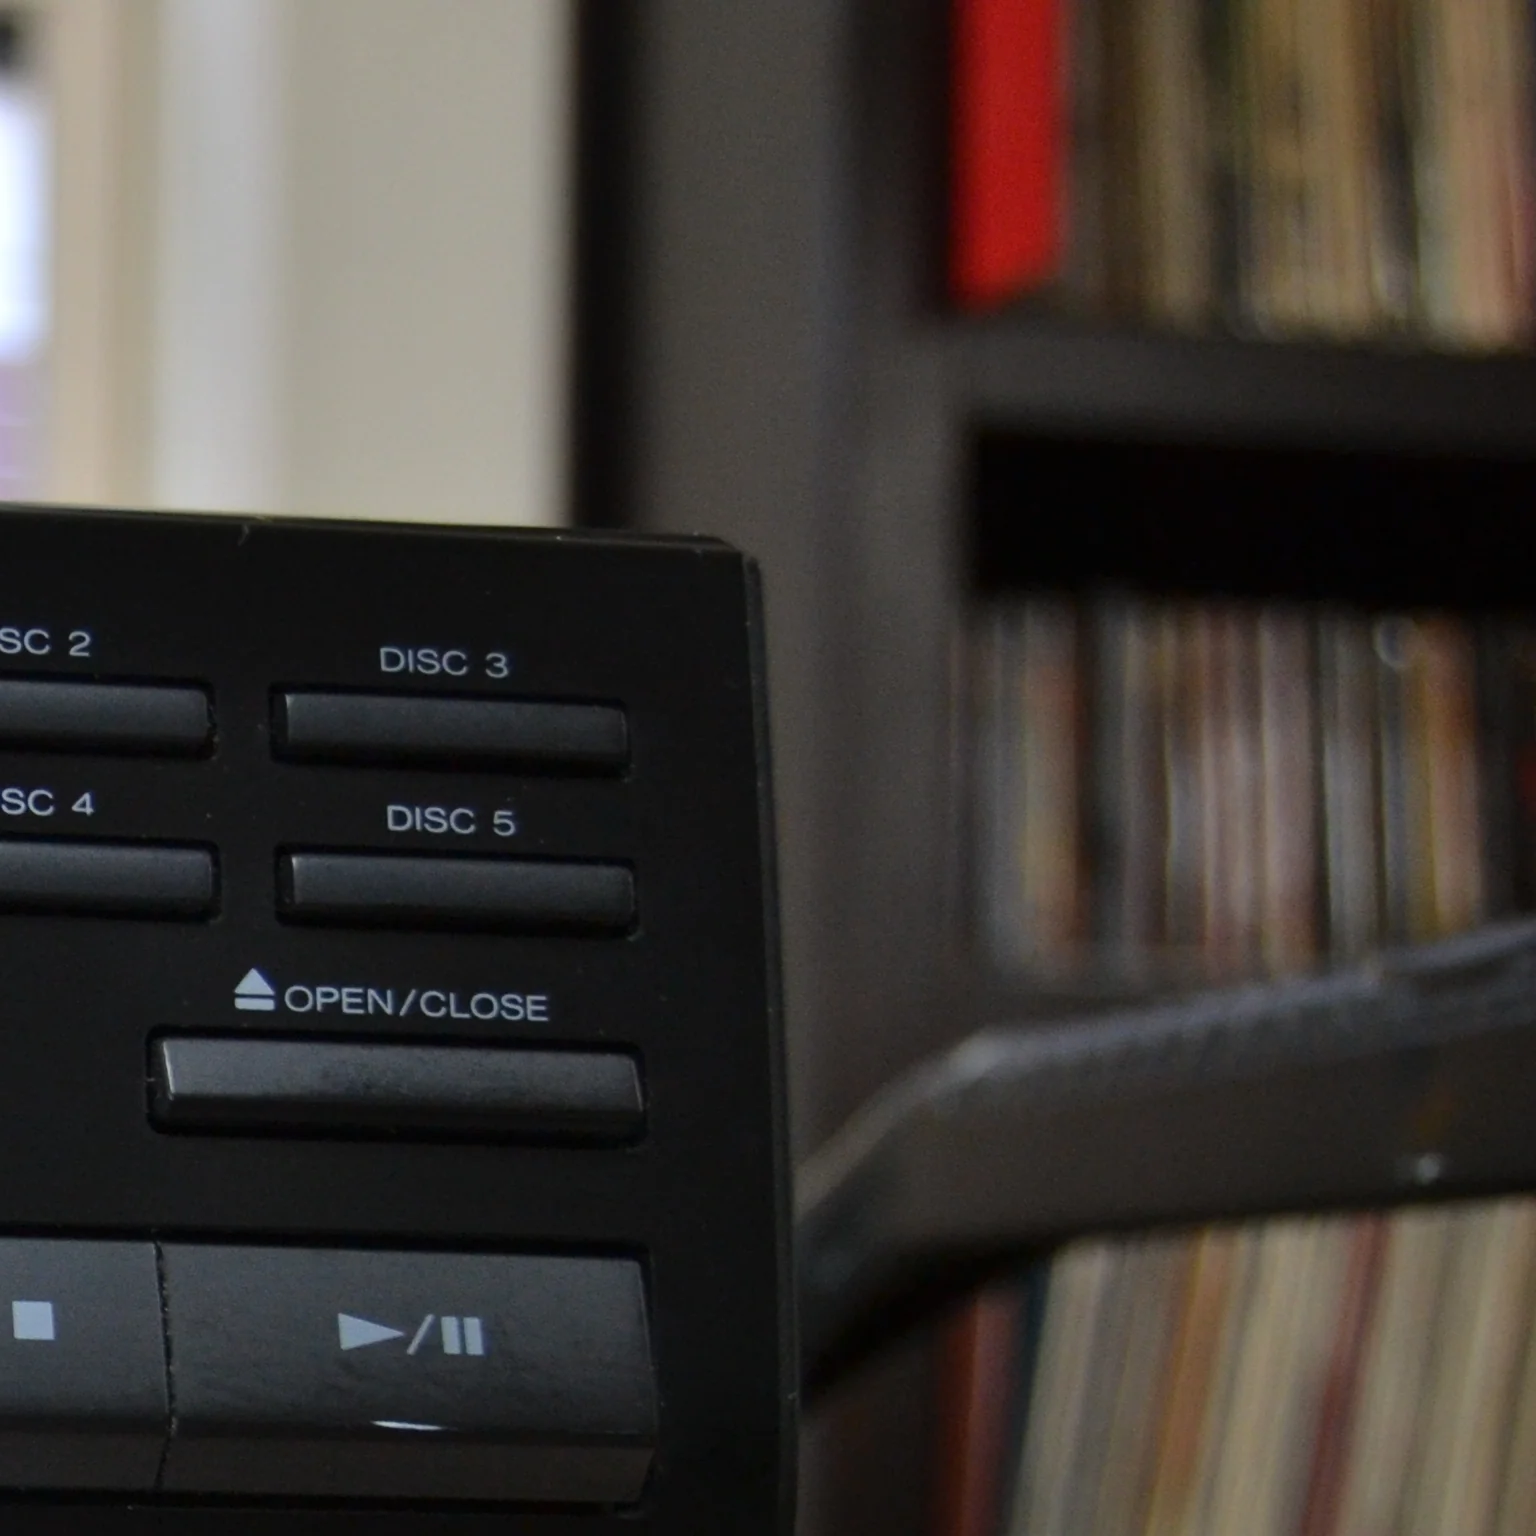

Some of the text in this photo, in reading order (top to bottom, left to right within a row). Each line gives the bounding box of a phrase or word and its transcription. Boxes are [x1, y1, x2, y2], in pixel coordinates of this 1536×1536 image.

[68, 629, 92, 658] 2
[378, 646, 510, 679] DISC 3
[69, 790, 95, 817] 4
[386, 804, 516, 838] DISC 5
[283, 985, 550, 1022] OPEN/CLOSE
